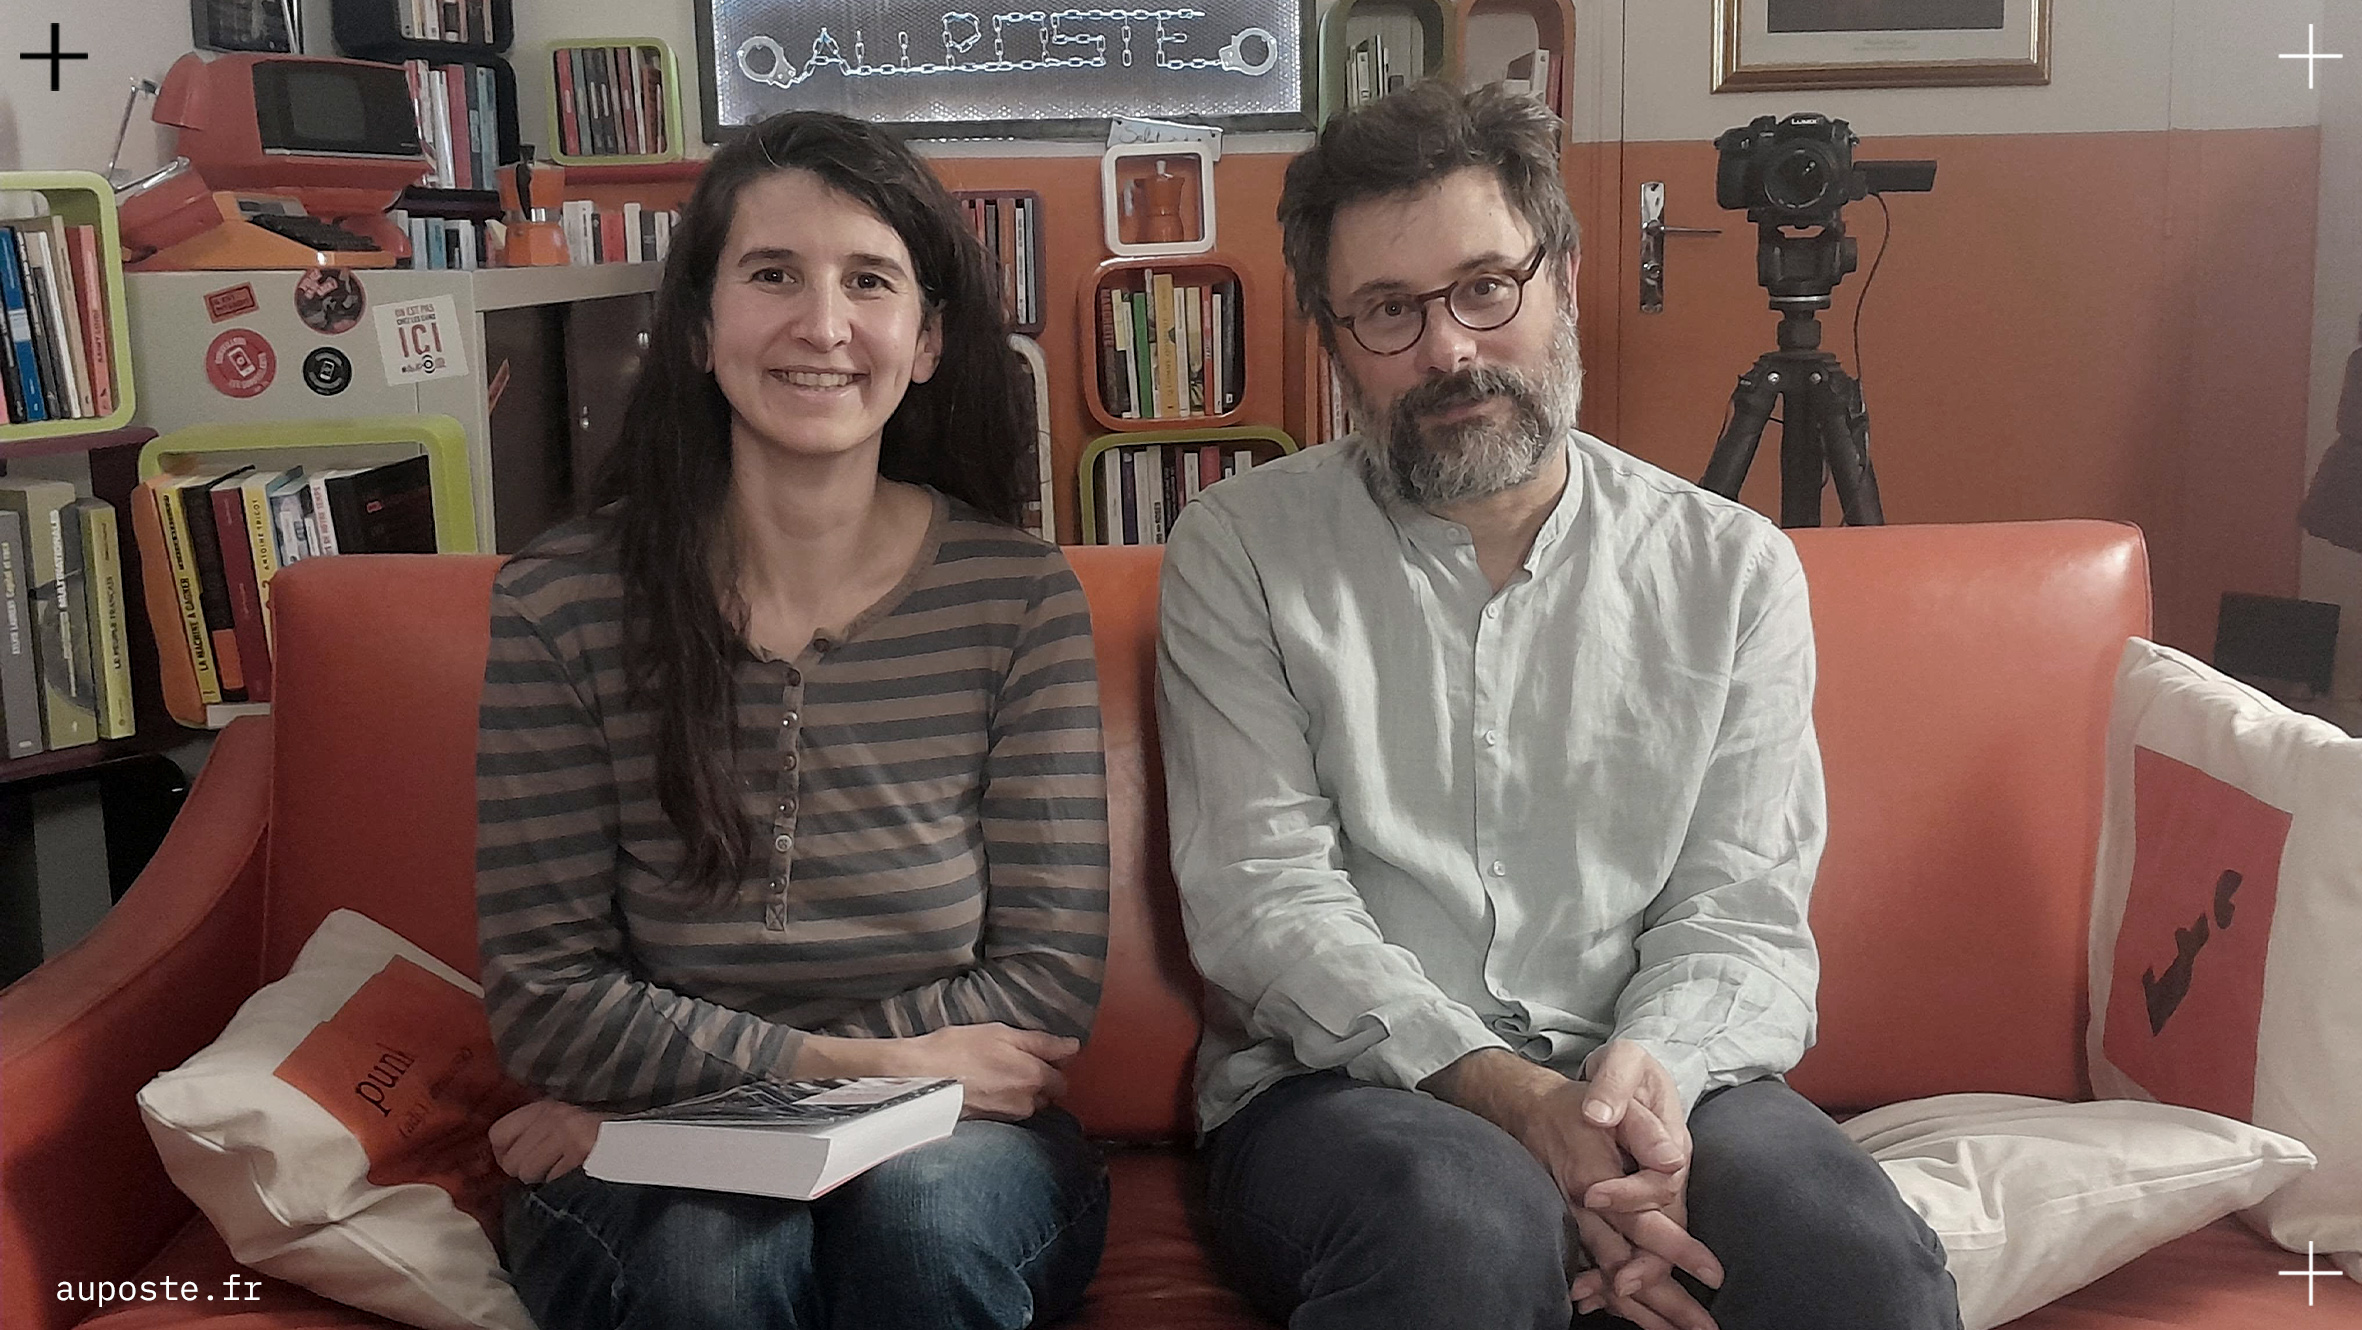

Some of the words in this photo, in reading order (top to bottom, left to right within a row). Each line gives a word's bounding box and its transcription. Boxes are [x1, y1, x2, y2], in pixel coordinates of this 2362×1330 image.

[399, 322, 442, 358] ICI
[257, 533, 270, 571] ANTOINE
[199, 659, 209, 672] LA
